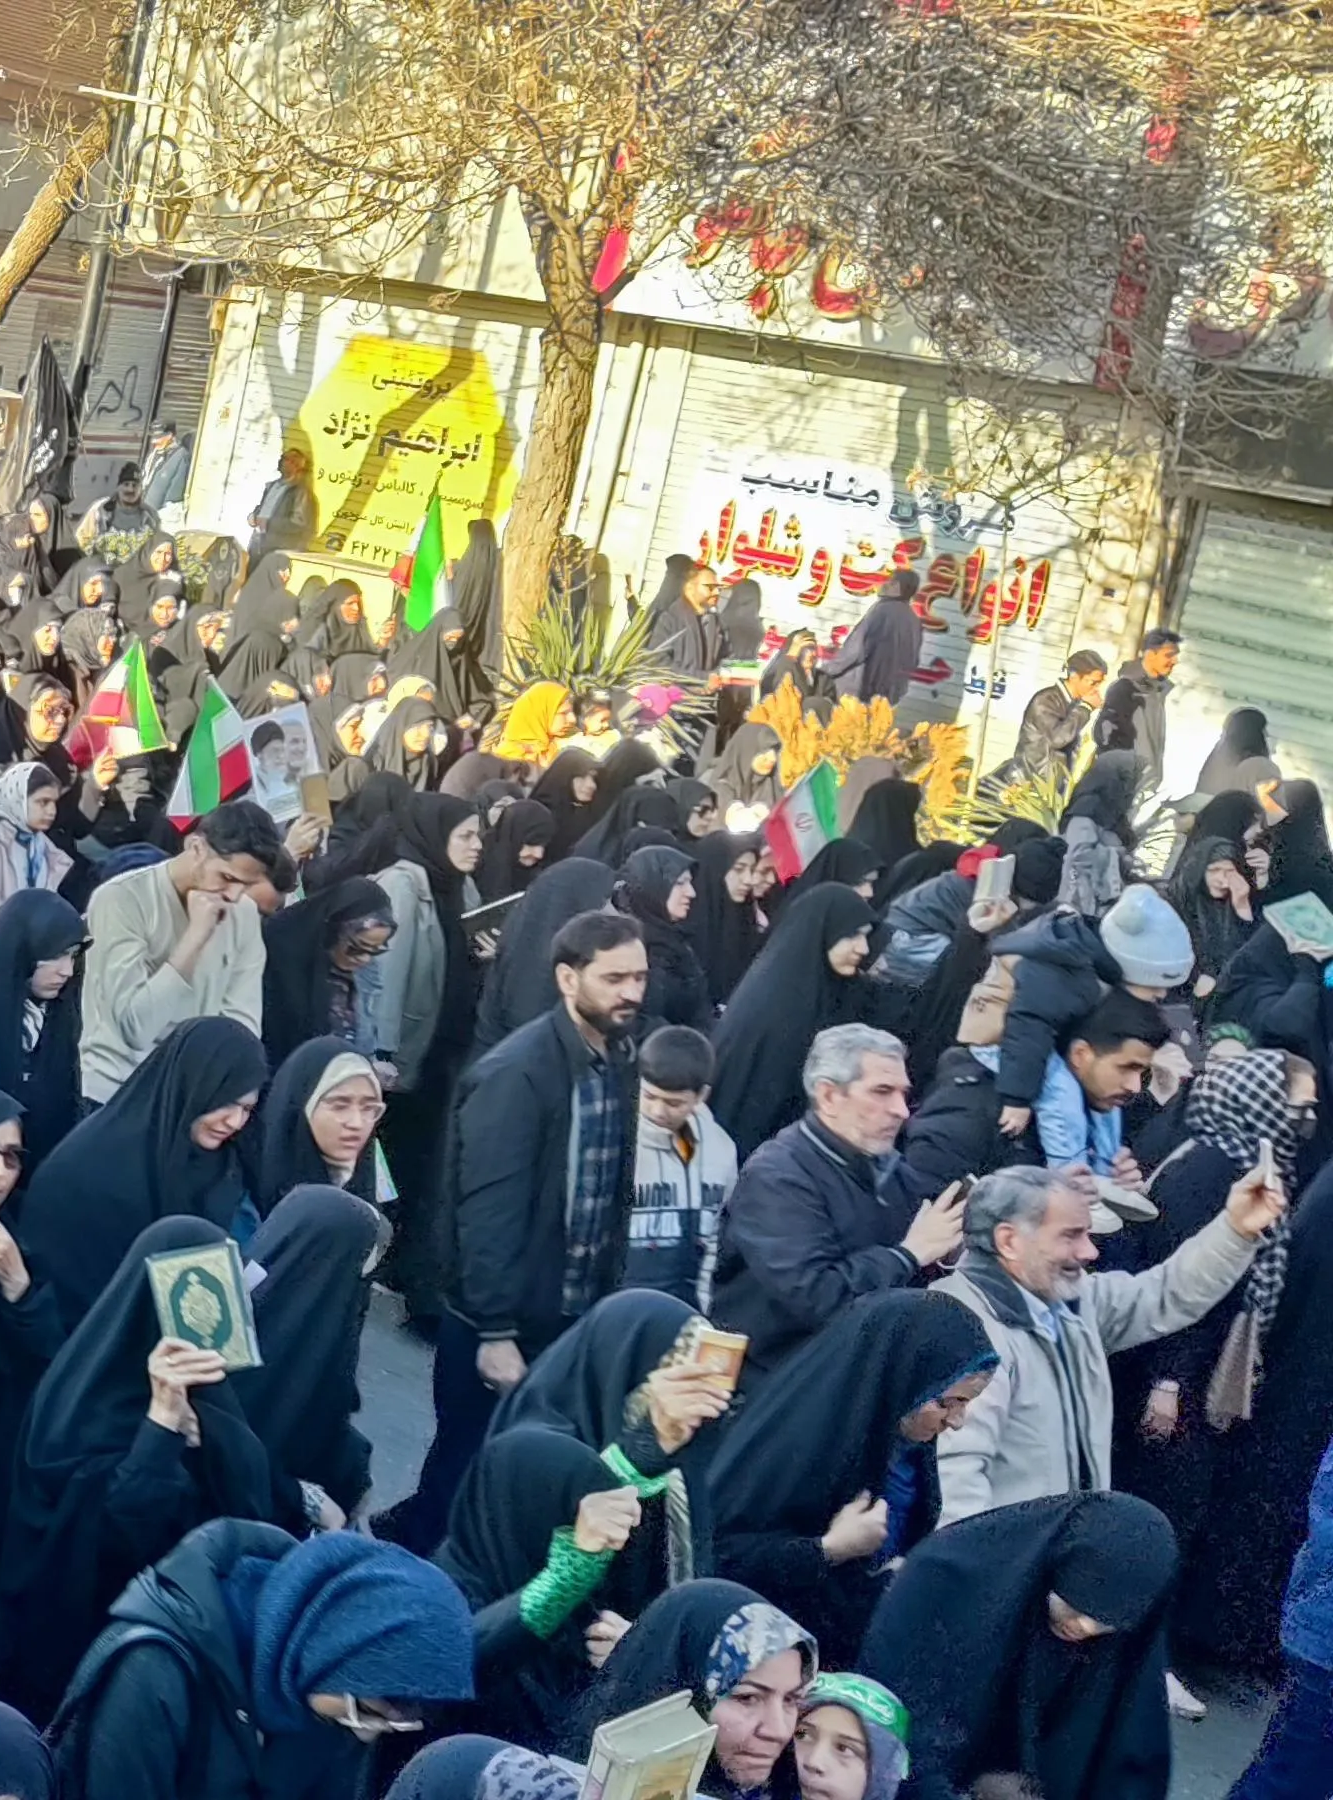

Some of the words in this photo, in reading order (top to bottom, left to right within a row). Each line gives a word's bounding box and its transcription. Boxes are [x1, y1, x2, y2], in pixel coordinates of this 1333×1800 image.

[323, 408, 370, 449] نژاد
[377, 427, 482, 469] ابراهیم
[740, 470, 881, 508] مناسب
[695, 499, 803, 587] شلوار
[798, 547, 832, 608] و
[911, 547, 1052, 645] انواع
